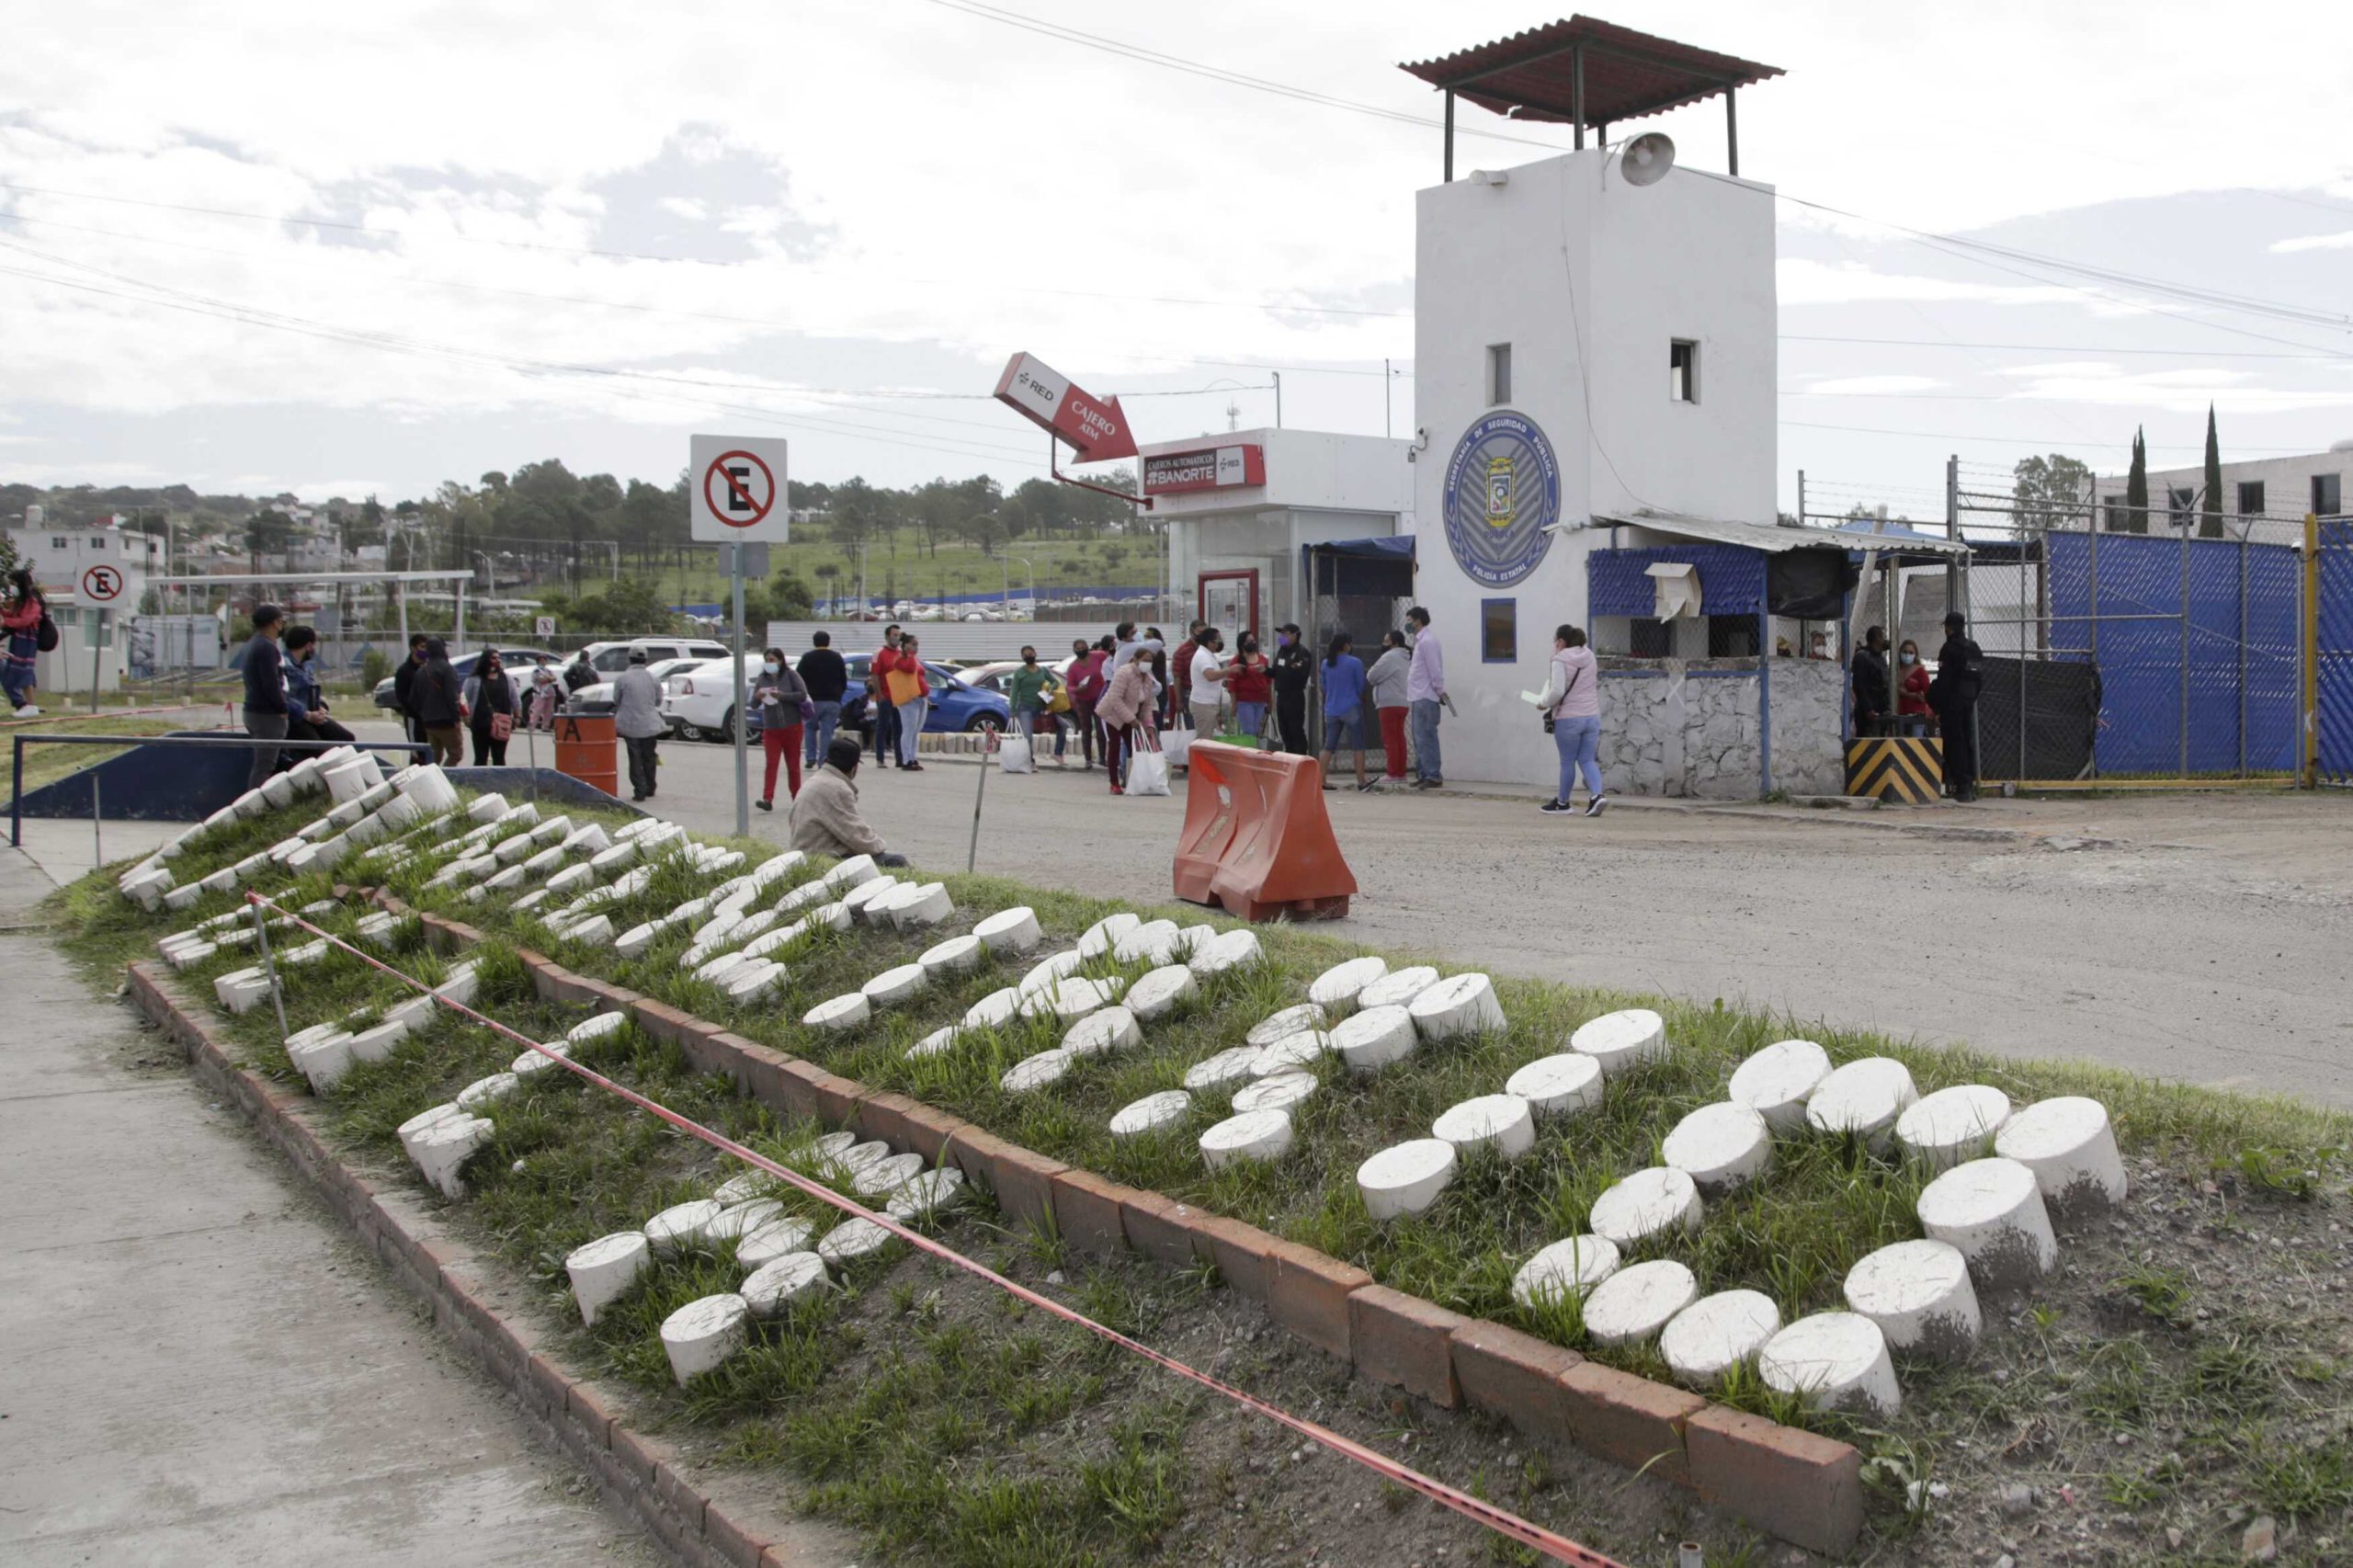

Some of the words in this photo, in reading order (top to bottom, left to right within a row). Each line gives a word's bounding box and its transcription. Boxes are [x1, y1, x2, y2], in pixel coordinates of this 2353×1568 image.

[1029, 380, 1055, 403] RED
[1072, 400, 1116, 437] CAJERO
[1079, 422, 1099, 441] ATM
[1473, 427, 1484, 439] DE
[1487, 418, 1528, 434] SEGURIDAD
[1532, 436, 1554, 479] PÚBLICA
[1147, 459, 1171, 472] CAJEROS
[1158, 465, 1214, 485] BANORTE
[729, 467, 750, 511] E
[1472, 563, 1497, 582] POLICÍA
[1499, 562, 1528, 581] ESTATAL
[563, 717, 582, 743] A
